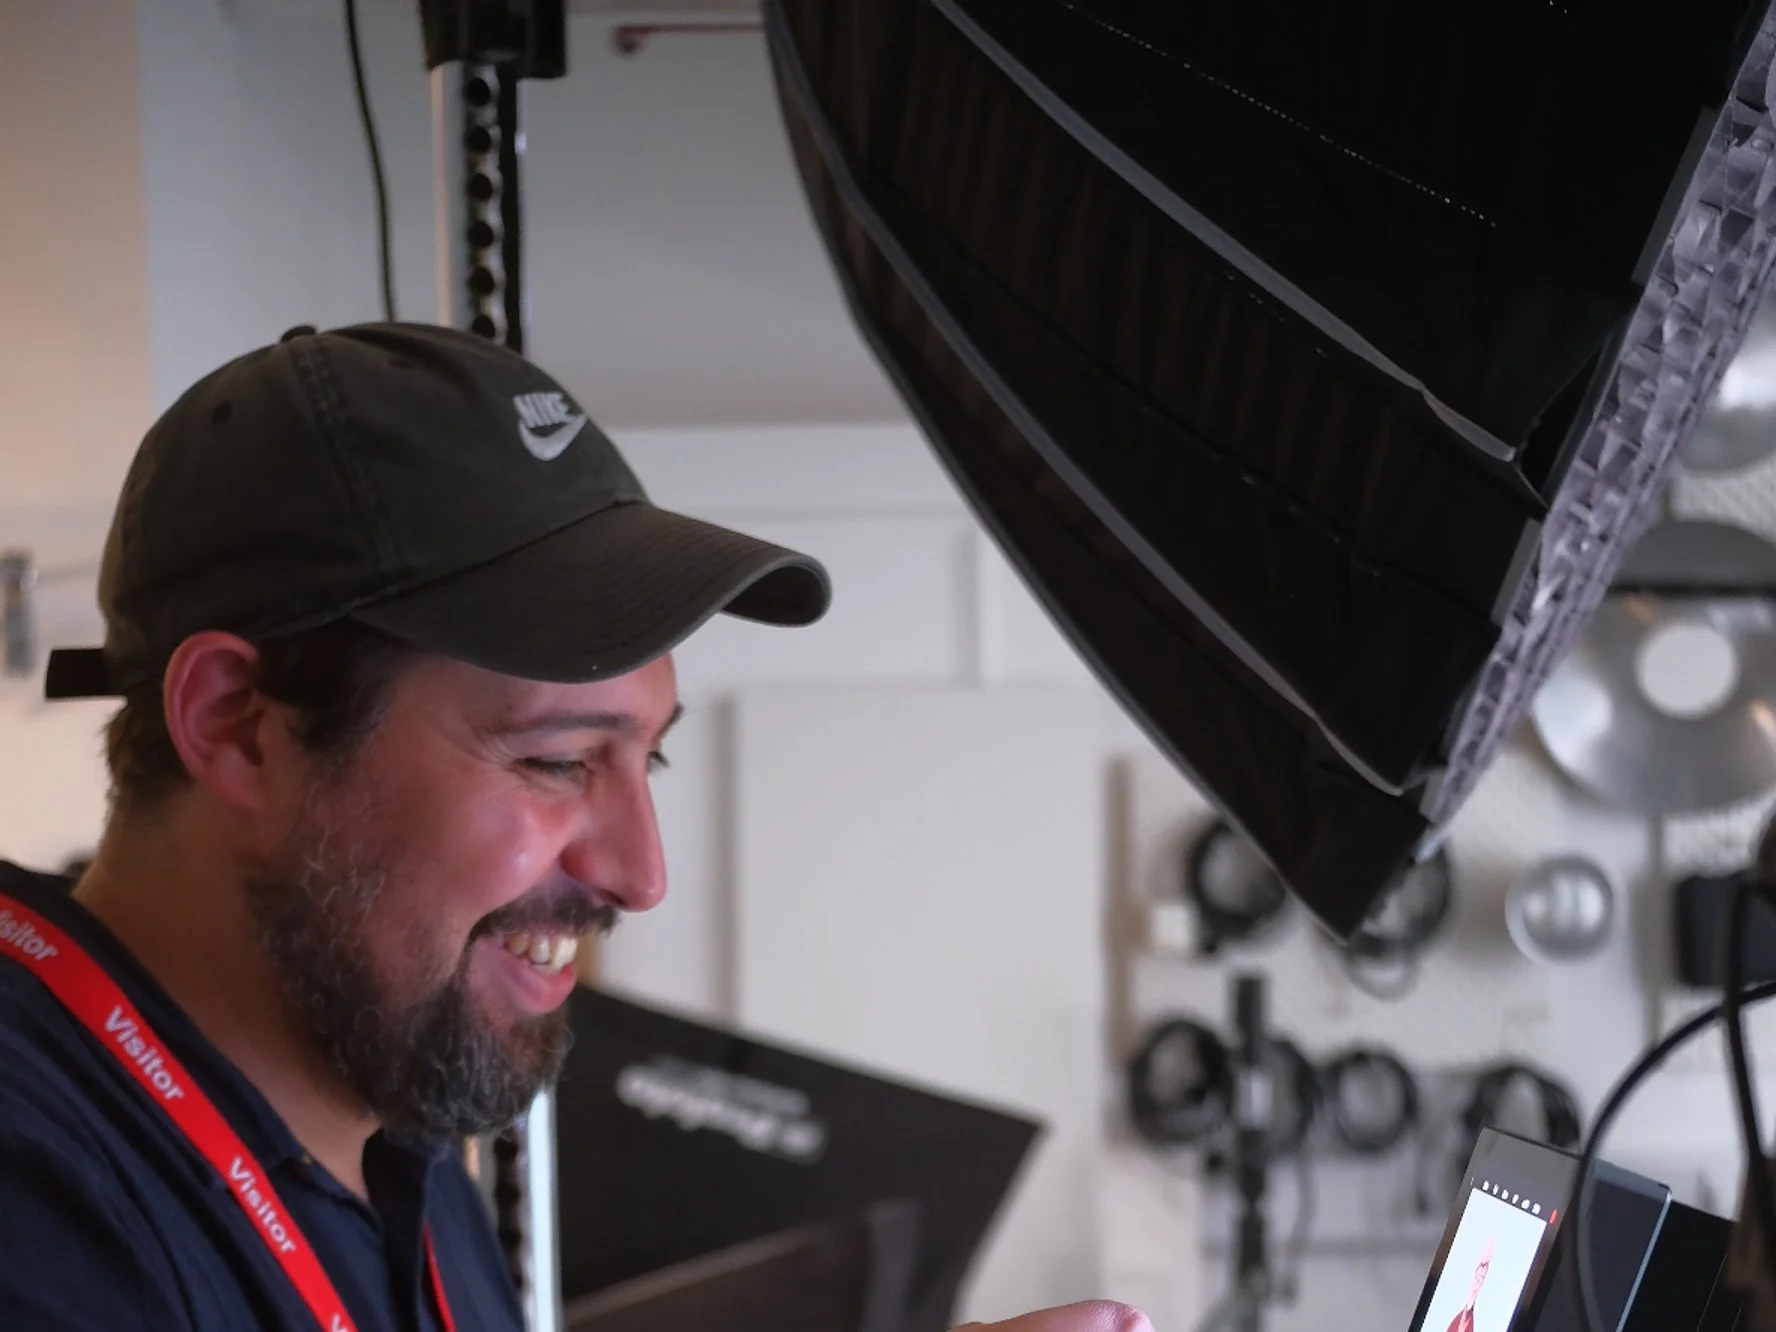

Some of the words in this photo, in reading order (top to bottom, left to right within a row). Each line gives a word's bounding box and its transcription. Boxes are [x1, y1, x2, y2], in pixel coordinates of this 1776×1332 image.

[512, 391, 570, 428] NIKE
[103, 1005, 186, 1102] Visitor
[228, 1156, 298, 1255] Visitor
